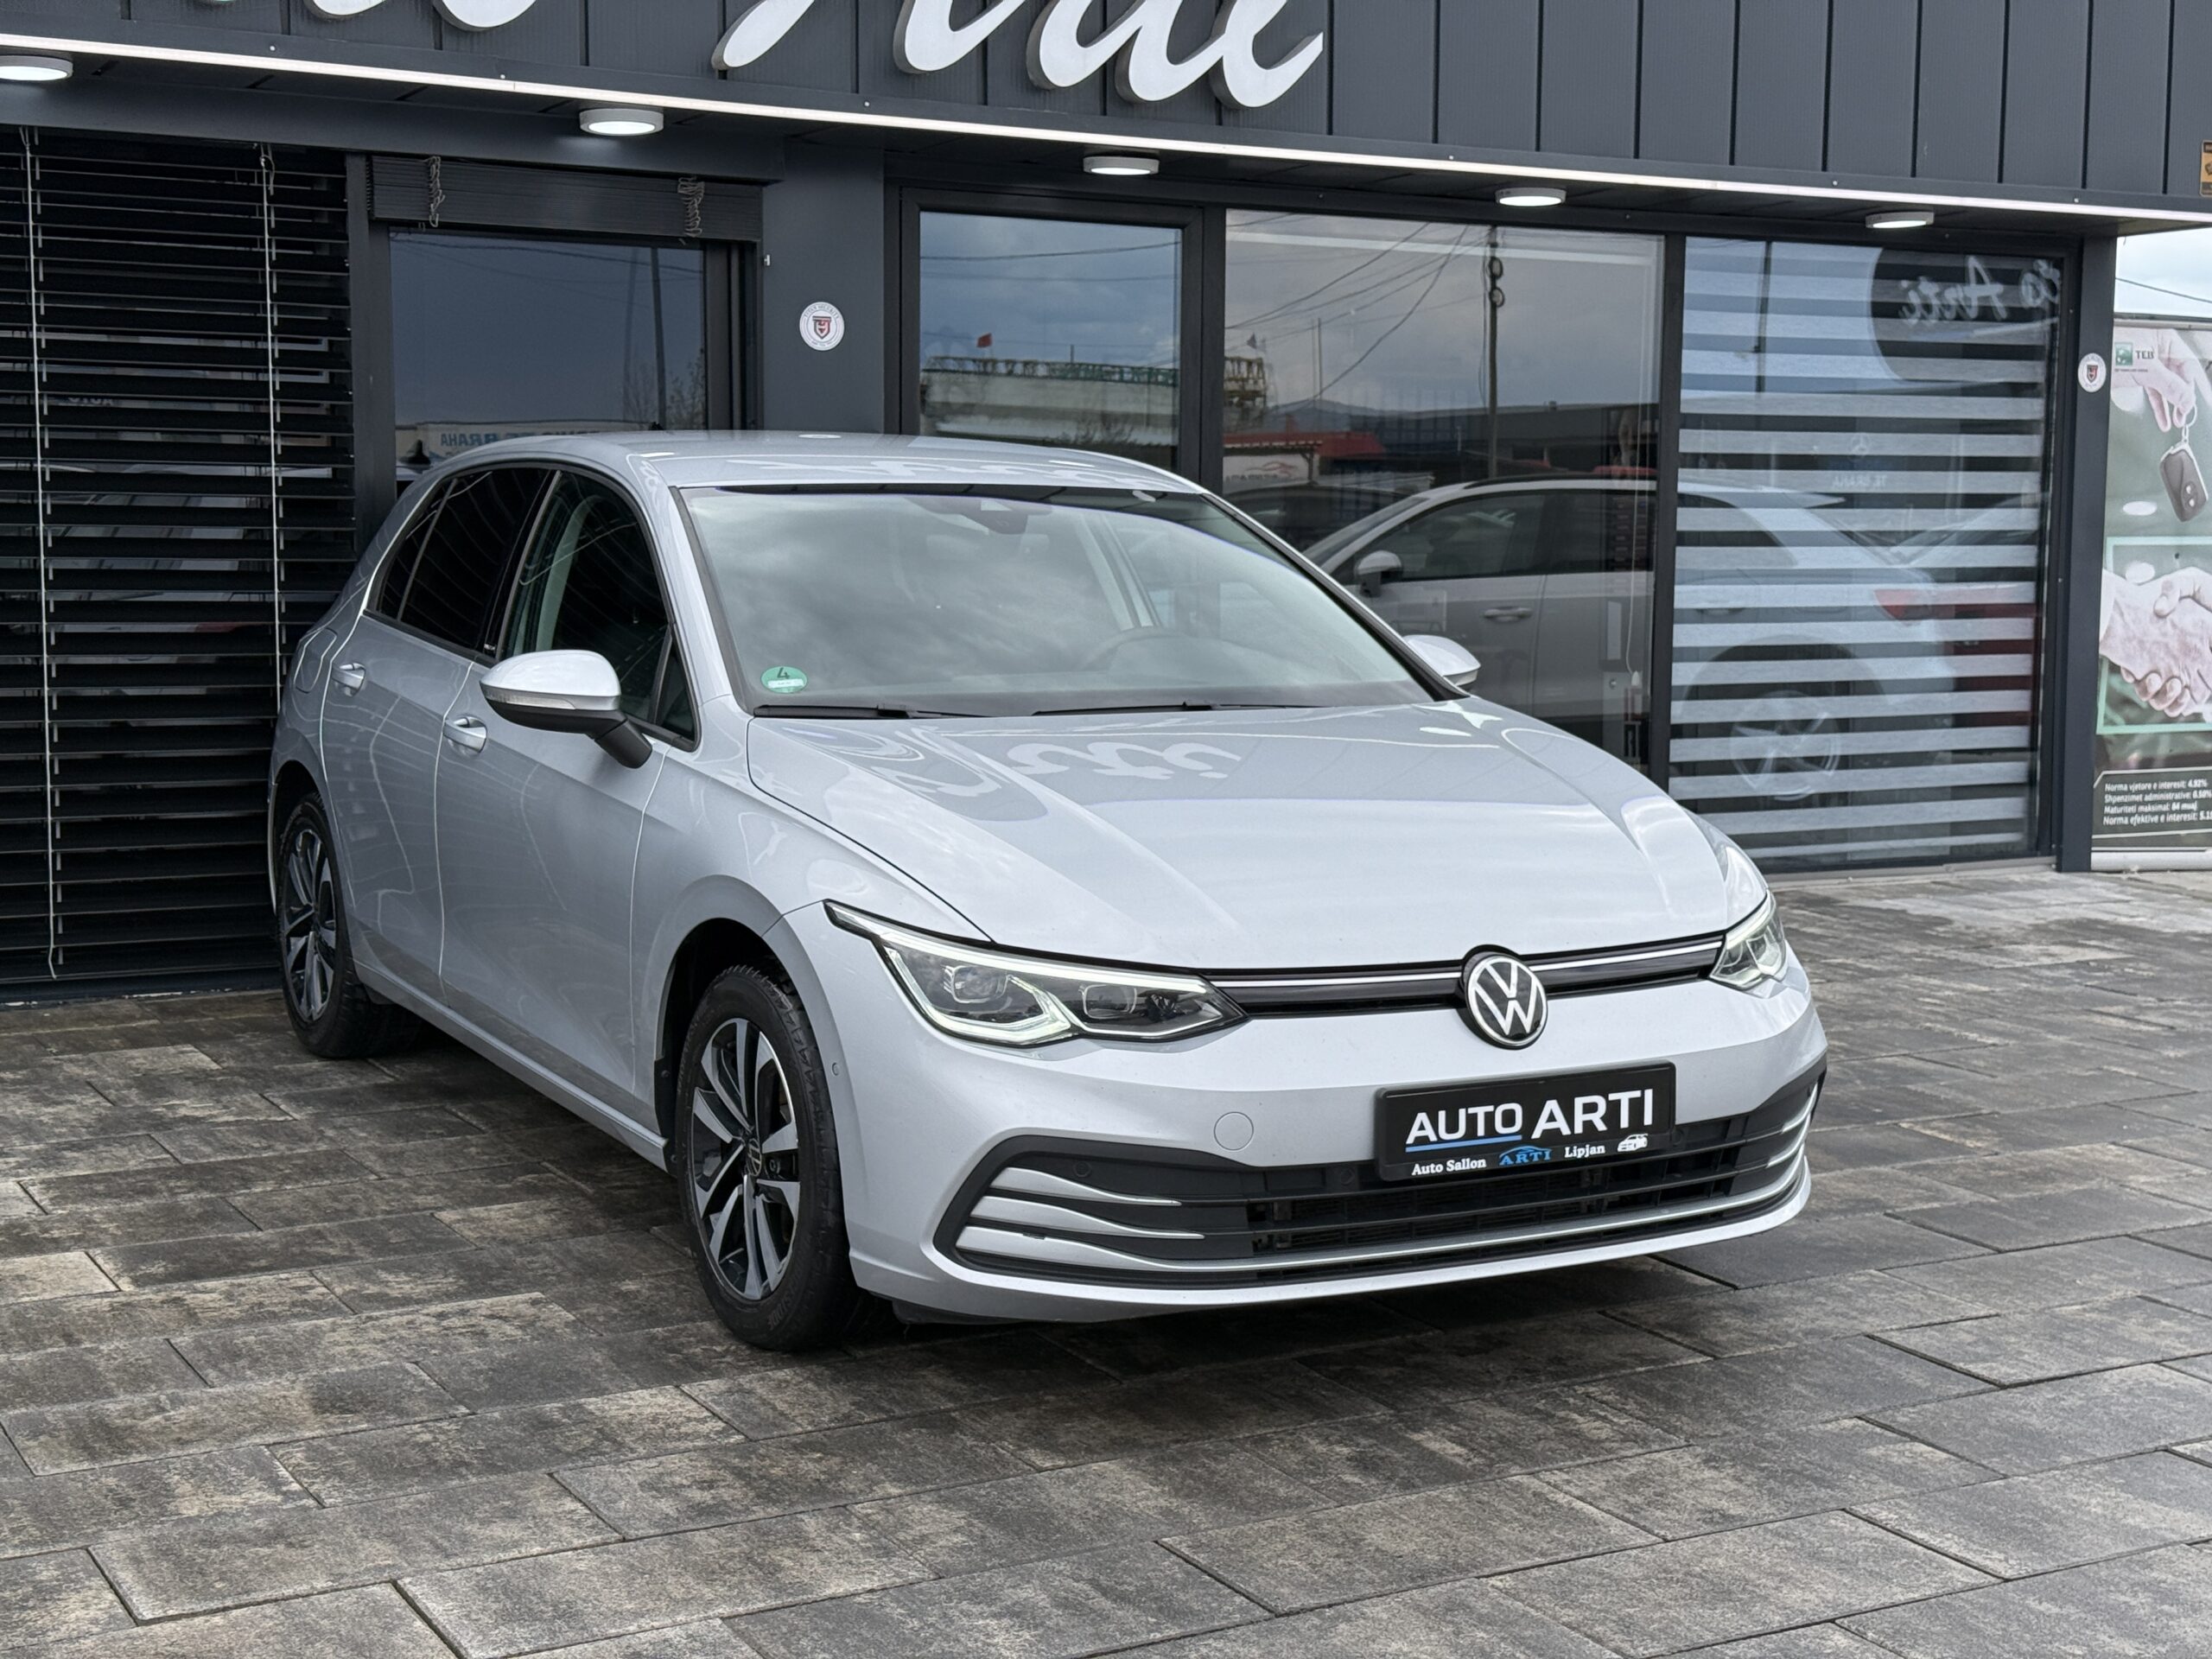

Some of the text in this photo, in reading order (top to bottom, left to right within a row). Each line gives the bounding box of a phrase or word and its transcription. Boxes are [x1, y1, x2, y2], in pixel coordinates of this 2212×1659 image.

[2135, 350, 2155, 359] TEB
[777, 667, 791, 680] 4
[2105, 783, 2128, 791] Norma
[2129, 782, 2152, 792] vjetore
[2104, 793, 2143, 804] Shpenzimet
[2144, 791, 2191, 802] administrative:
[2104, 804, 2137, 814] Maturiteti
[2181, 800, 2197, 811] muaj
[2103, 816, 2128, 825] Norma
[2129, 814, 2158, 827] efektive
[2166, 812, 2198, 823] interesit:
[1406, 1089, 1654, 1145] AUTO ARTI
[1499, 1150, 1552, 1166] ARTI
[1564, 1144, 1606, 1159] Lipjan
[1411, 1158, 1487, 1176] Auto Sallon
